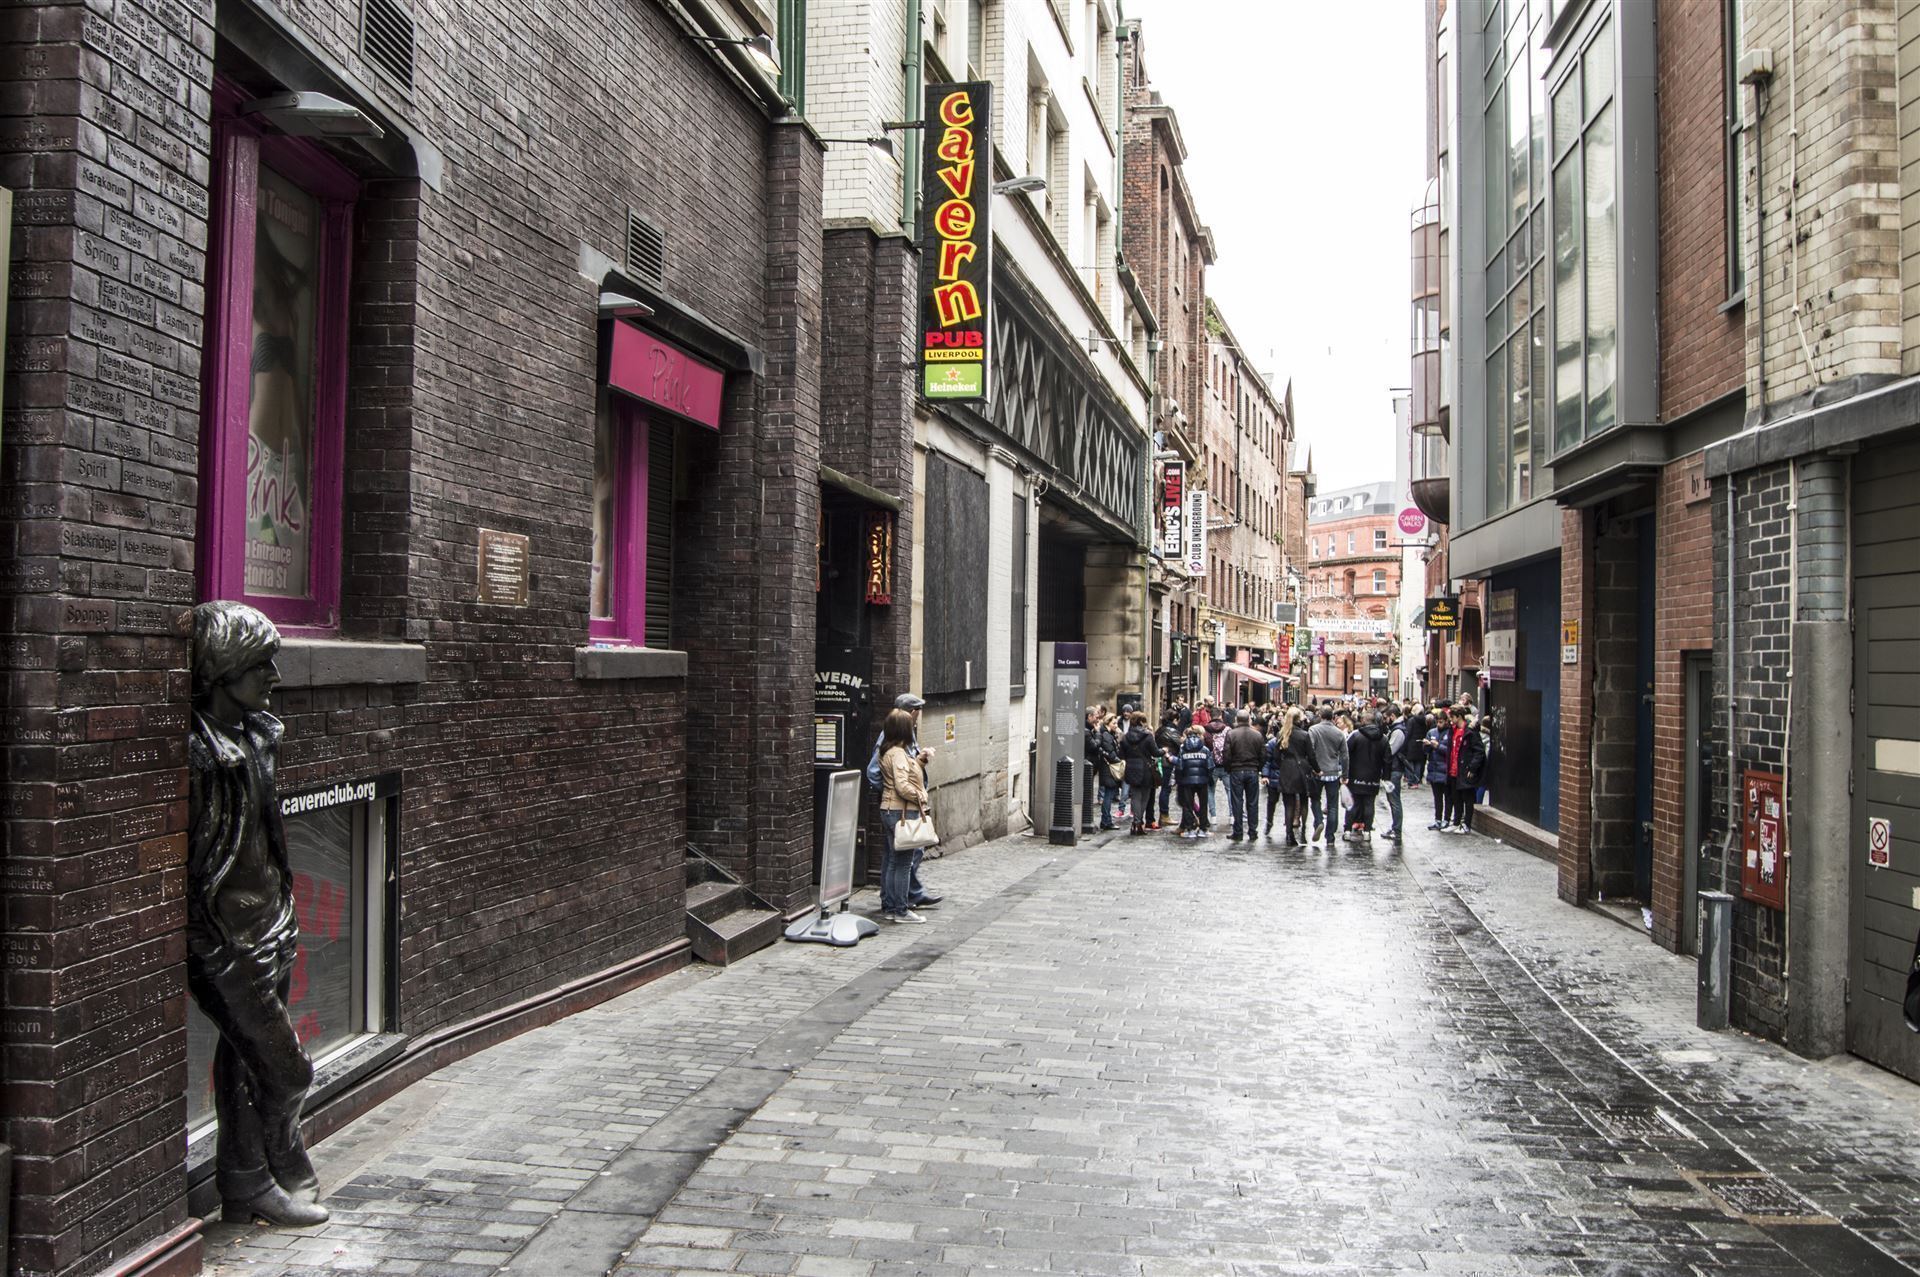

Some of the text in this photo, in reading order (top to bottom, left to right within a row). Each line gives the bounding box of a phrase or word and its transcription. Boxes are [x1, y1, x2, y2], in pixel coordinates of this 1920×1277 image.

[111, 28, 134, 53] Valley
[121, 17, 158, 49] Jazz Band
[85, 28, 138, 71] Skiffle Group
[173, 51, 187, 69] The
[113, 70, 163, 114] Moonstone
[101, 97, 116, 113] The
[94, 107, 122, 131] Triffids
[183, 114, 194, 129] The
[140, 125, 183, 160] Chapter Six
[110, 143, 159, 182] Normie Rowe
[83, 167, 127, 198] Karakorum
[172, 186, 184, 203] The
[140, 197, 178, 226] The Crew
[934, 92, 982, 327] cavern
[110, 210, 152, 240] Strawberry
[121, 230, 141, 249] Blues
[177, 242, 189, 257] The
[85, 240, 119, 270] Spring
[134, 273, 142, 283] of
[145, 277, 155, 289] the
[143, 261, 170, 283] Children
[104, 280, 119, 295] Earl
[121, 286, 144, 306] Royce
[102, 294, 152, 322] The Olympics
[92, 312, 107, 328] The
[161, 311, 189, 331] Jasmin
[81, 324, 117, 346] Trakkers
[926, 331, 983, 347] PUB
[103, 354, 120, 371] Dean
[123, 360, 142, 379] Stacy
[71, 379, 88, 395] Tony
[90, 385, 113, 402] Rivers
[100, 367, 151, 393] The Detonators
[649, 345, 691, 415] Pink
[930, 382, 976, 392] Heineken
[68, 393, 123, 419] The Castaways
[134, 395, 169, 420] The Song
[116, 426, 131, 440] The
[104, 438, 141, 457] Avengers
[152, 441, 196, 465] Quicksand
[78, 458, 107, 478] Spirit
[124, 470, 173, 492] Bitter Harvest
[1691, 474, 1700, 497] by
[94, 500, 109, 513] The
[1192, 493, 1202, 560] CLUB UNDERGROUND
[1400, 514, 1423, 525] CAVERN
[1402, 520, 1422, 529] WALKS
[63, 529, 117, 551] Stackridge
[124, 540, 169, 557] Able Fletcher
[252, 539, 292, 563] Entrance
[67, 605, 109, 624] Sponge
[815, 671, 863, 689] AVERN
